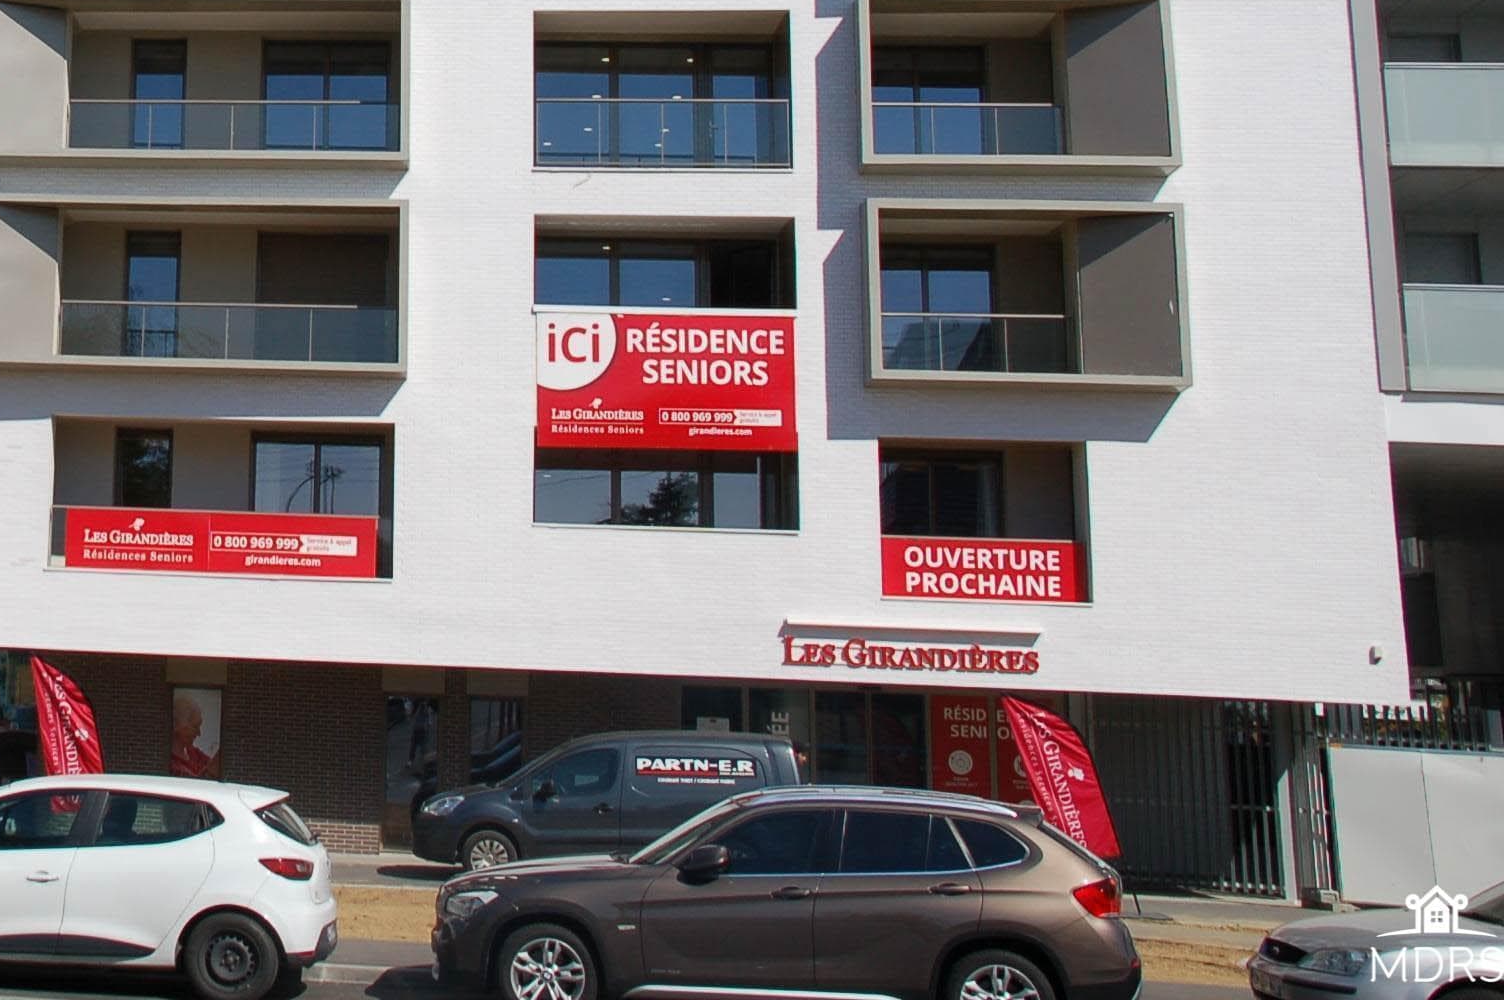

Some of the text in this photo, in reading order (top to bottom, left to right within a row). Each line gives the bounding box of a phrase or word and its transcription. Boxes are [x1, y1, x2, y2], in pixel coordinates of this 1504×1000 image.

[625, 322, 785, 355] RÉSIDENCE
[642, 358, 769, 386] SENIORS
[551, 407, 571, 420] LES
[671, 411, 690, 422] 800
[83, 528, 193, 546] LES GIRANDIÈRES
[214, 536, 298, 550] 0 800 969 999
[83, 549, 194, 563] Résidences Seniors
[245, 554, 321, 568] girandieres.com
[904, 546, 1060, 571] OUVERTURE
[905, 571, 1062, 597] PROCHAINE
[782, 635, 1040, 674] LES GIRANDIÈRES
